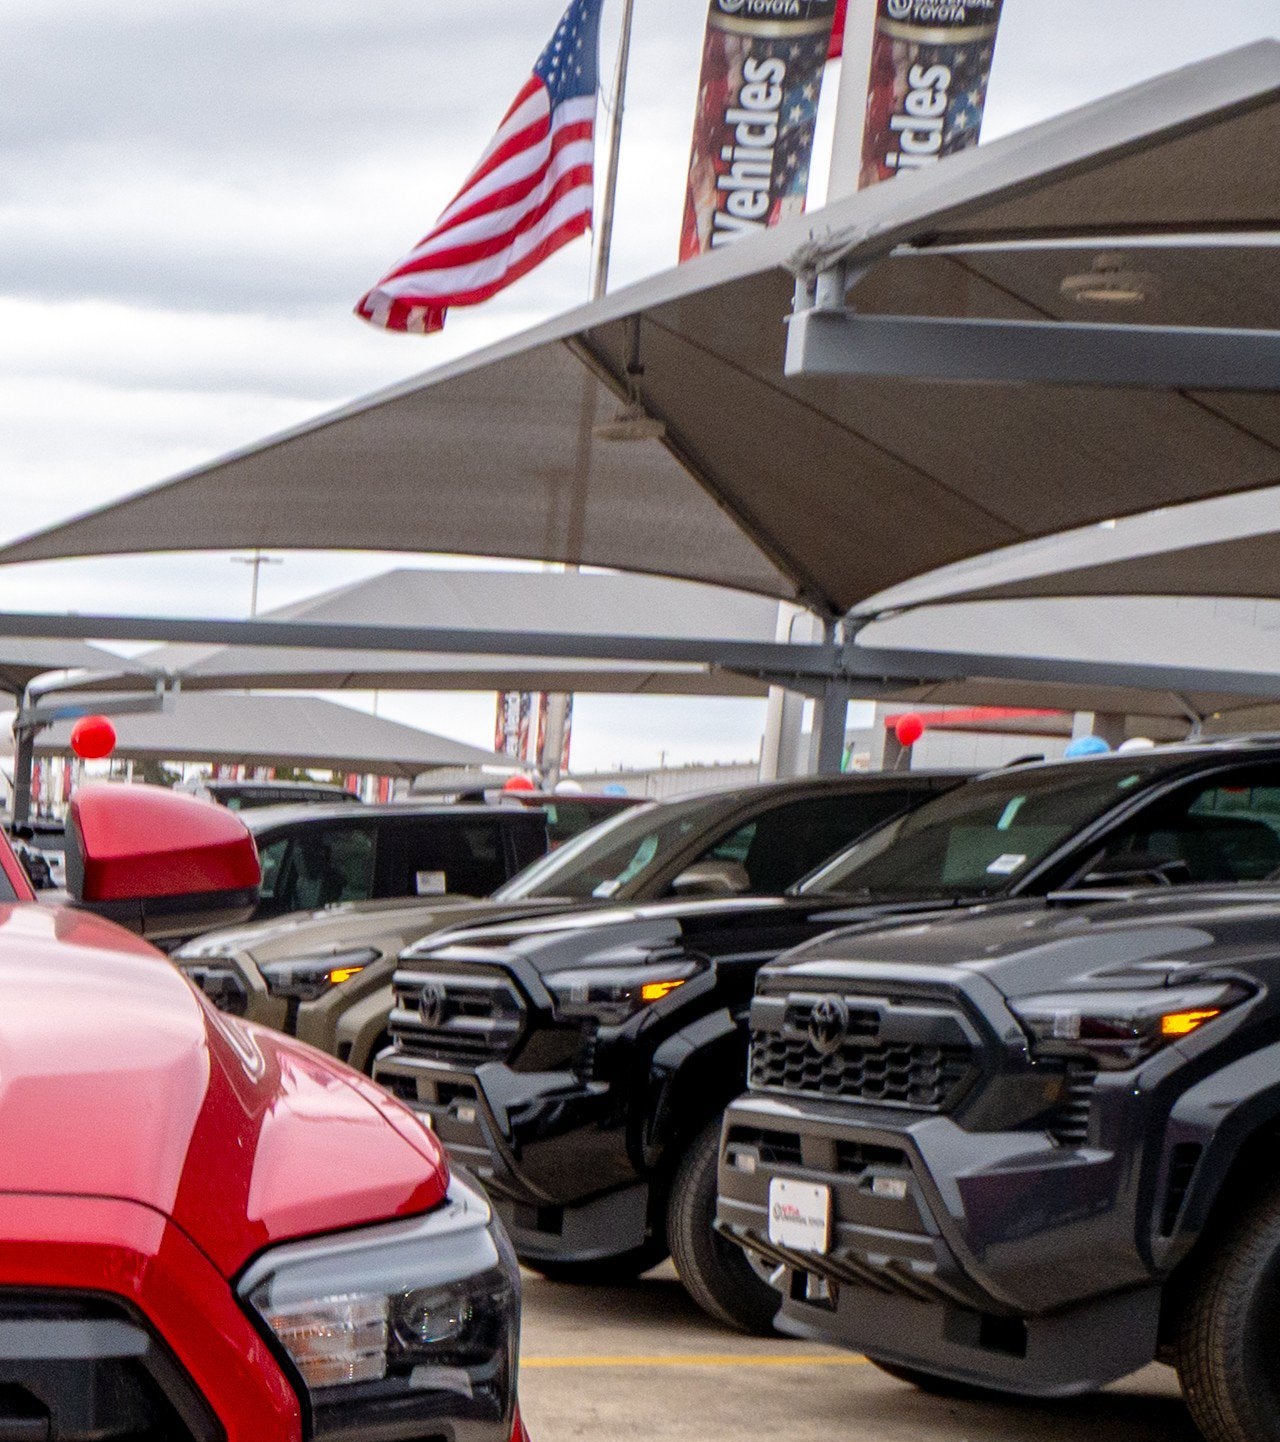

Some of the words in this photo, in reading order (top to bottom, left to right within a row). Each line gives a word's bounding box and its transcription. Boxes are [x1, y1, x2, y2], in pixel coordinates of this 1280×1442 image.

[913, 5, 966, 21] TOYOTA
[711, 56, 786, 249] Vehicles
[885, 63, 951, 168] icles
